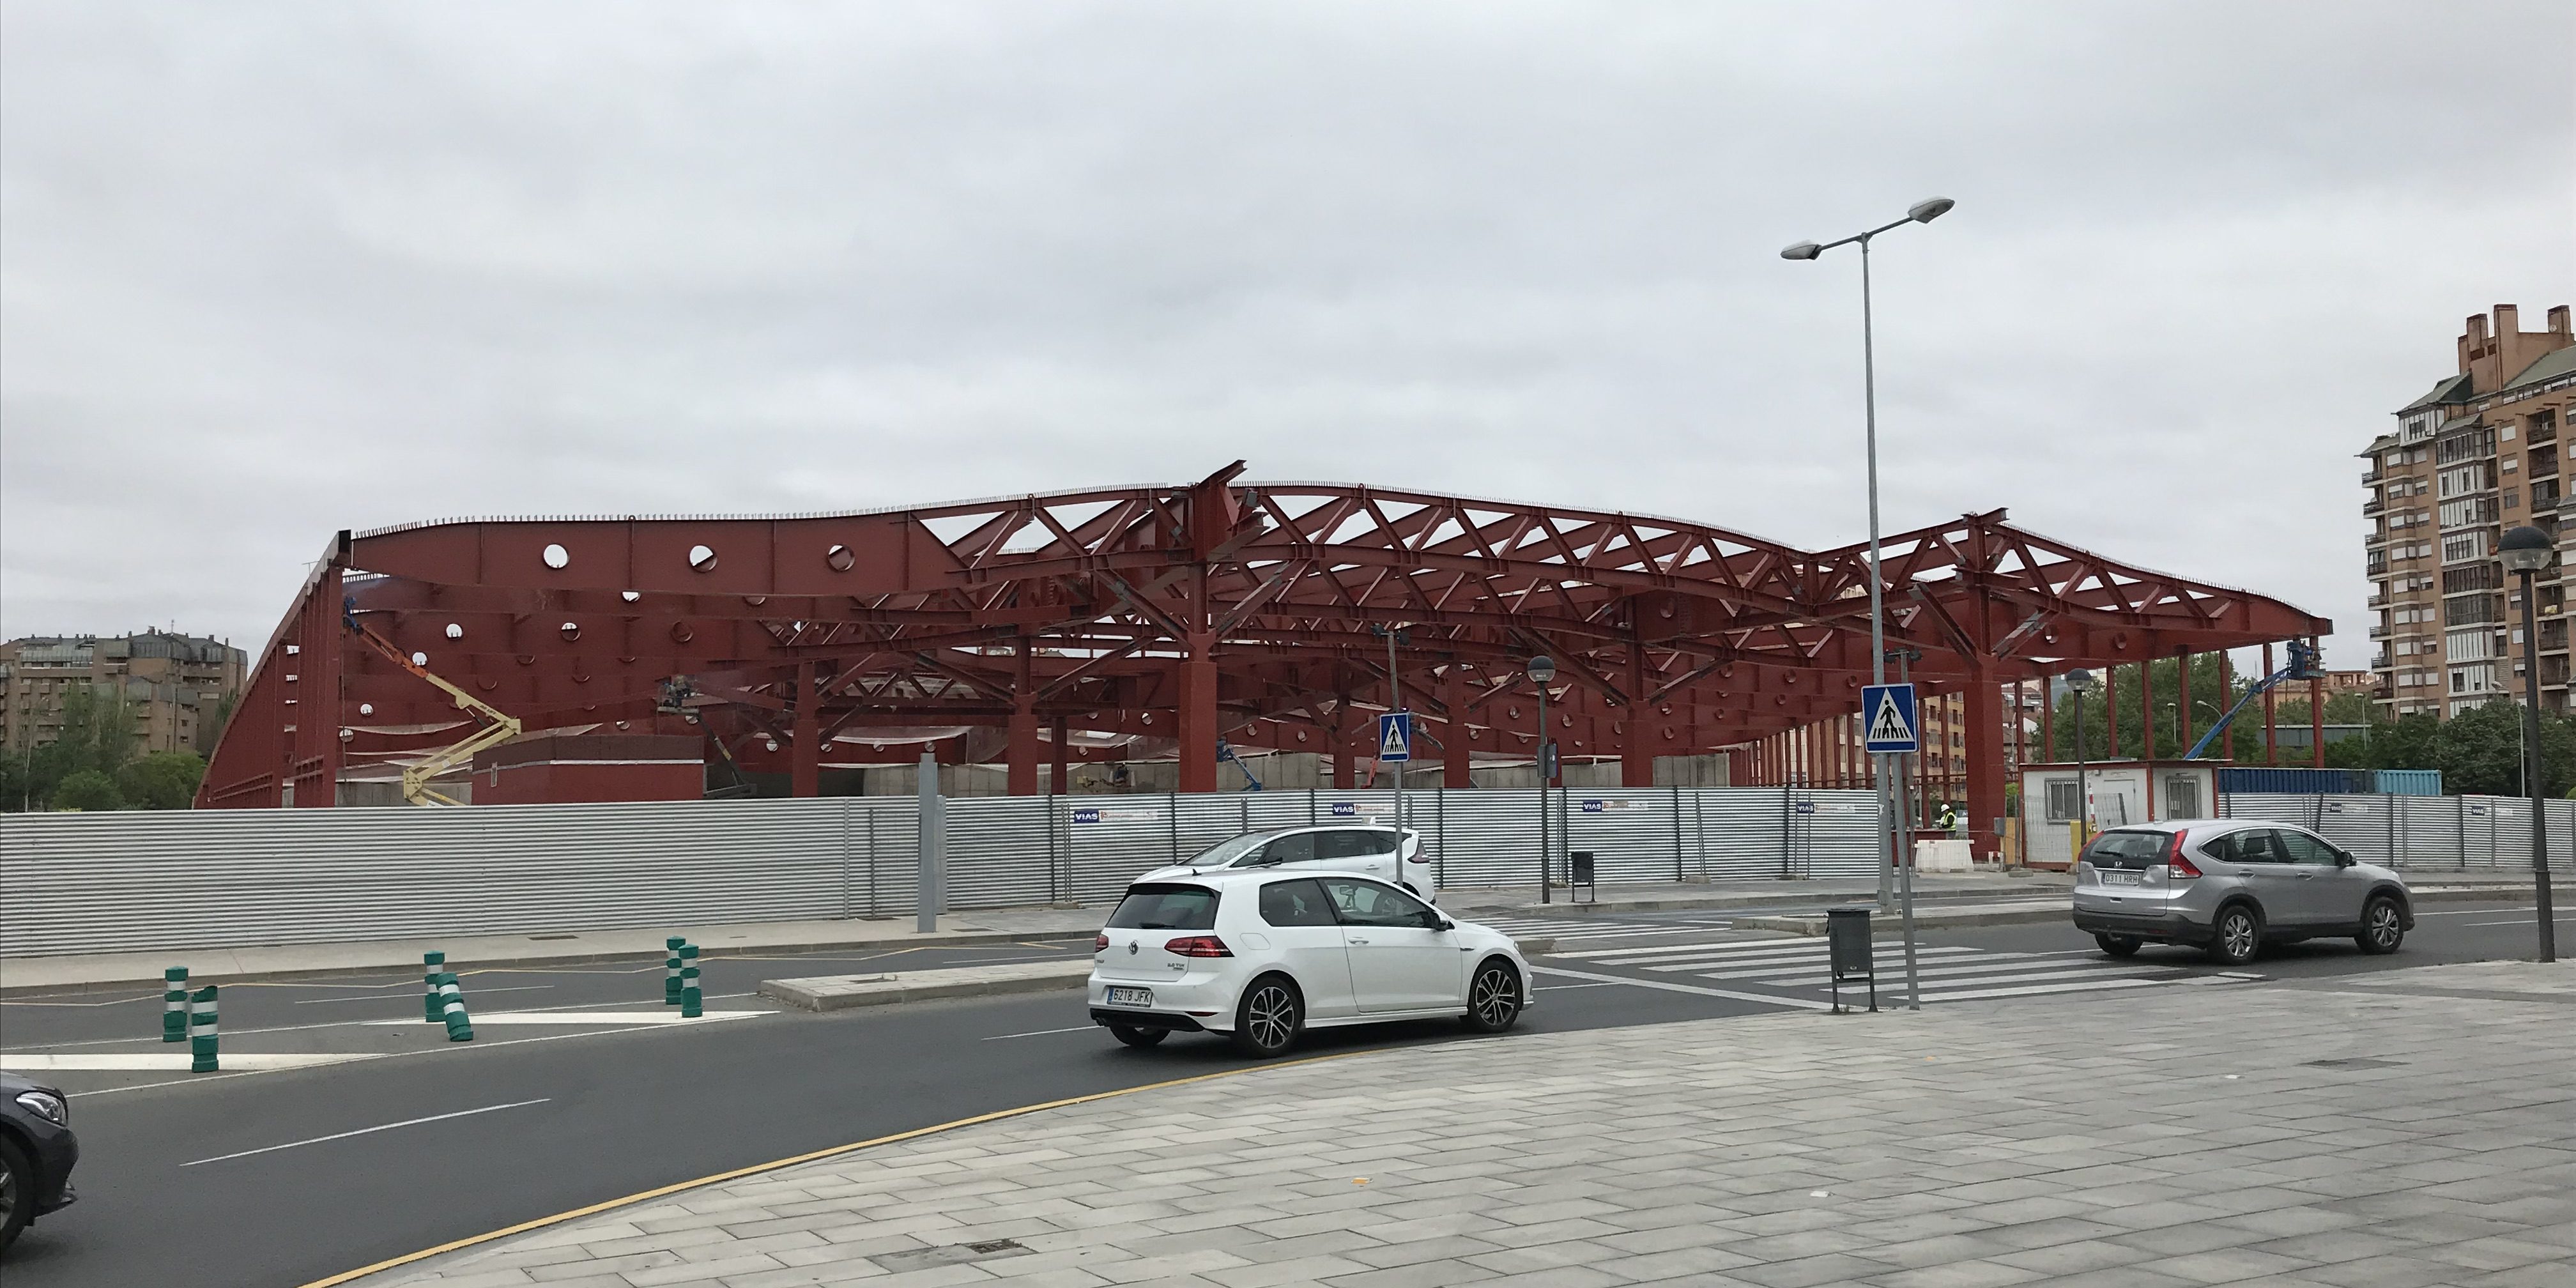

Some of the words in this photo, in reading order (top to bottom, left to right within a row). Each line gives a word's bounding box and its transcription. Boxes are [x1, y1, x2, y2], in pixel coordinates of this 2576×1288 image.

[2124, 875, 2138, 884] HRH
[1114, 990, 1133, 1001] 6218
[1135, 991, 1151, 1002] JFK
